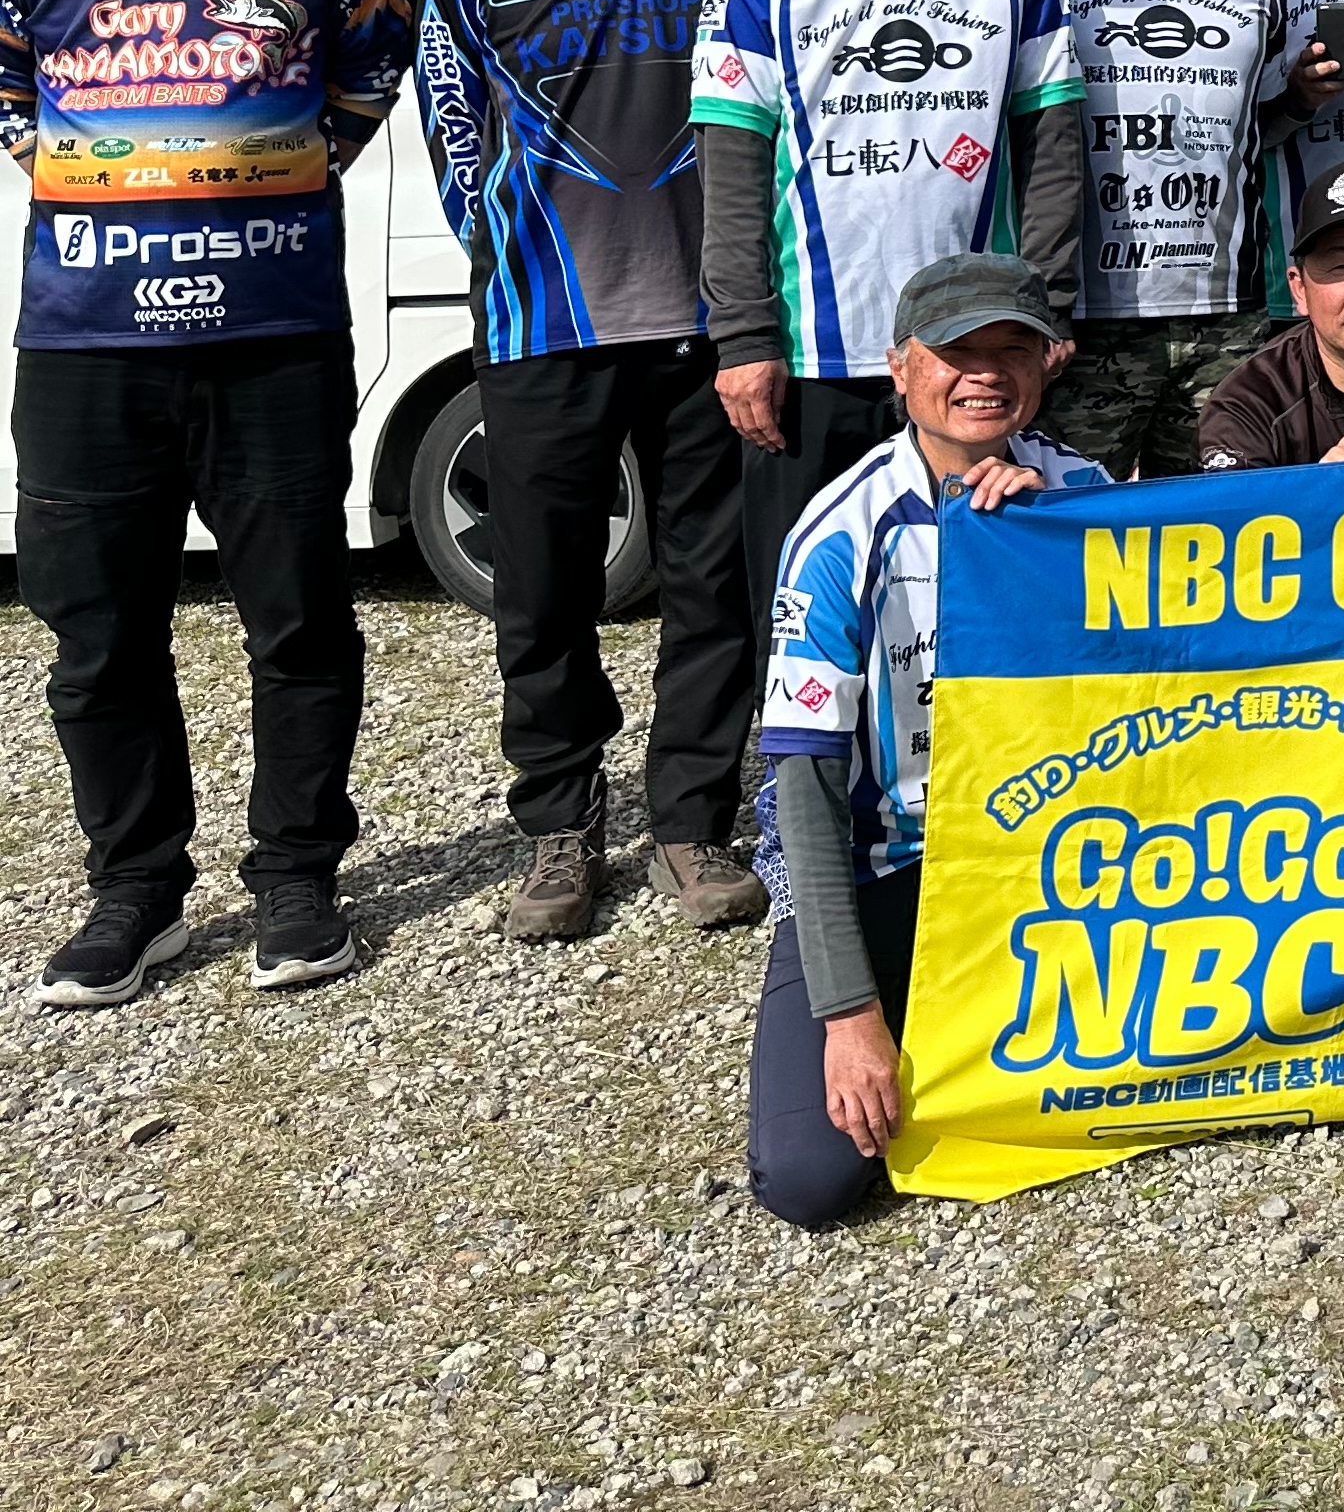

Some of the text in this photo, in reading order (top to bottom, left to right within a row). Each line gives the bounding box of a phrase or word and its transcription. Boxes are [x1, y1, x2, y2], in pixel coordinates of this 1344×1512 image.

[90, 0, 187, 38] Gary
[797, 9, 853, 50] Fight
[858, 0, 876, 22] it
[927, 0, 1006, 40] Fishing
[514, 15, 698, 73] KATSU
[60, 83, 228, 109] CUSTOM BAITS
[1091, 114, 1176, 153] FBI
[1185, 116, 1232, 126] FUJITAKA
[1185, 130, 1212, 139] BOAT
[1184, 143, 1232, 152] INDUSTRY
[1112, 219, 1205, 230] Lake-Nanairo
[1100, 241, 1216, 270] O.N. planning
[1083, 513, 1302, 631] NBC
